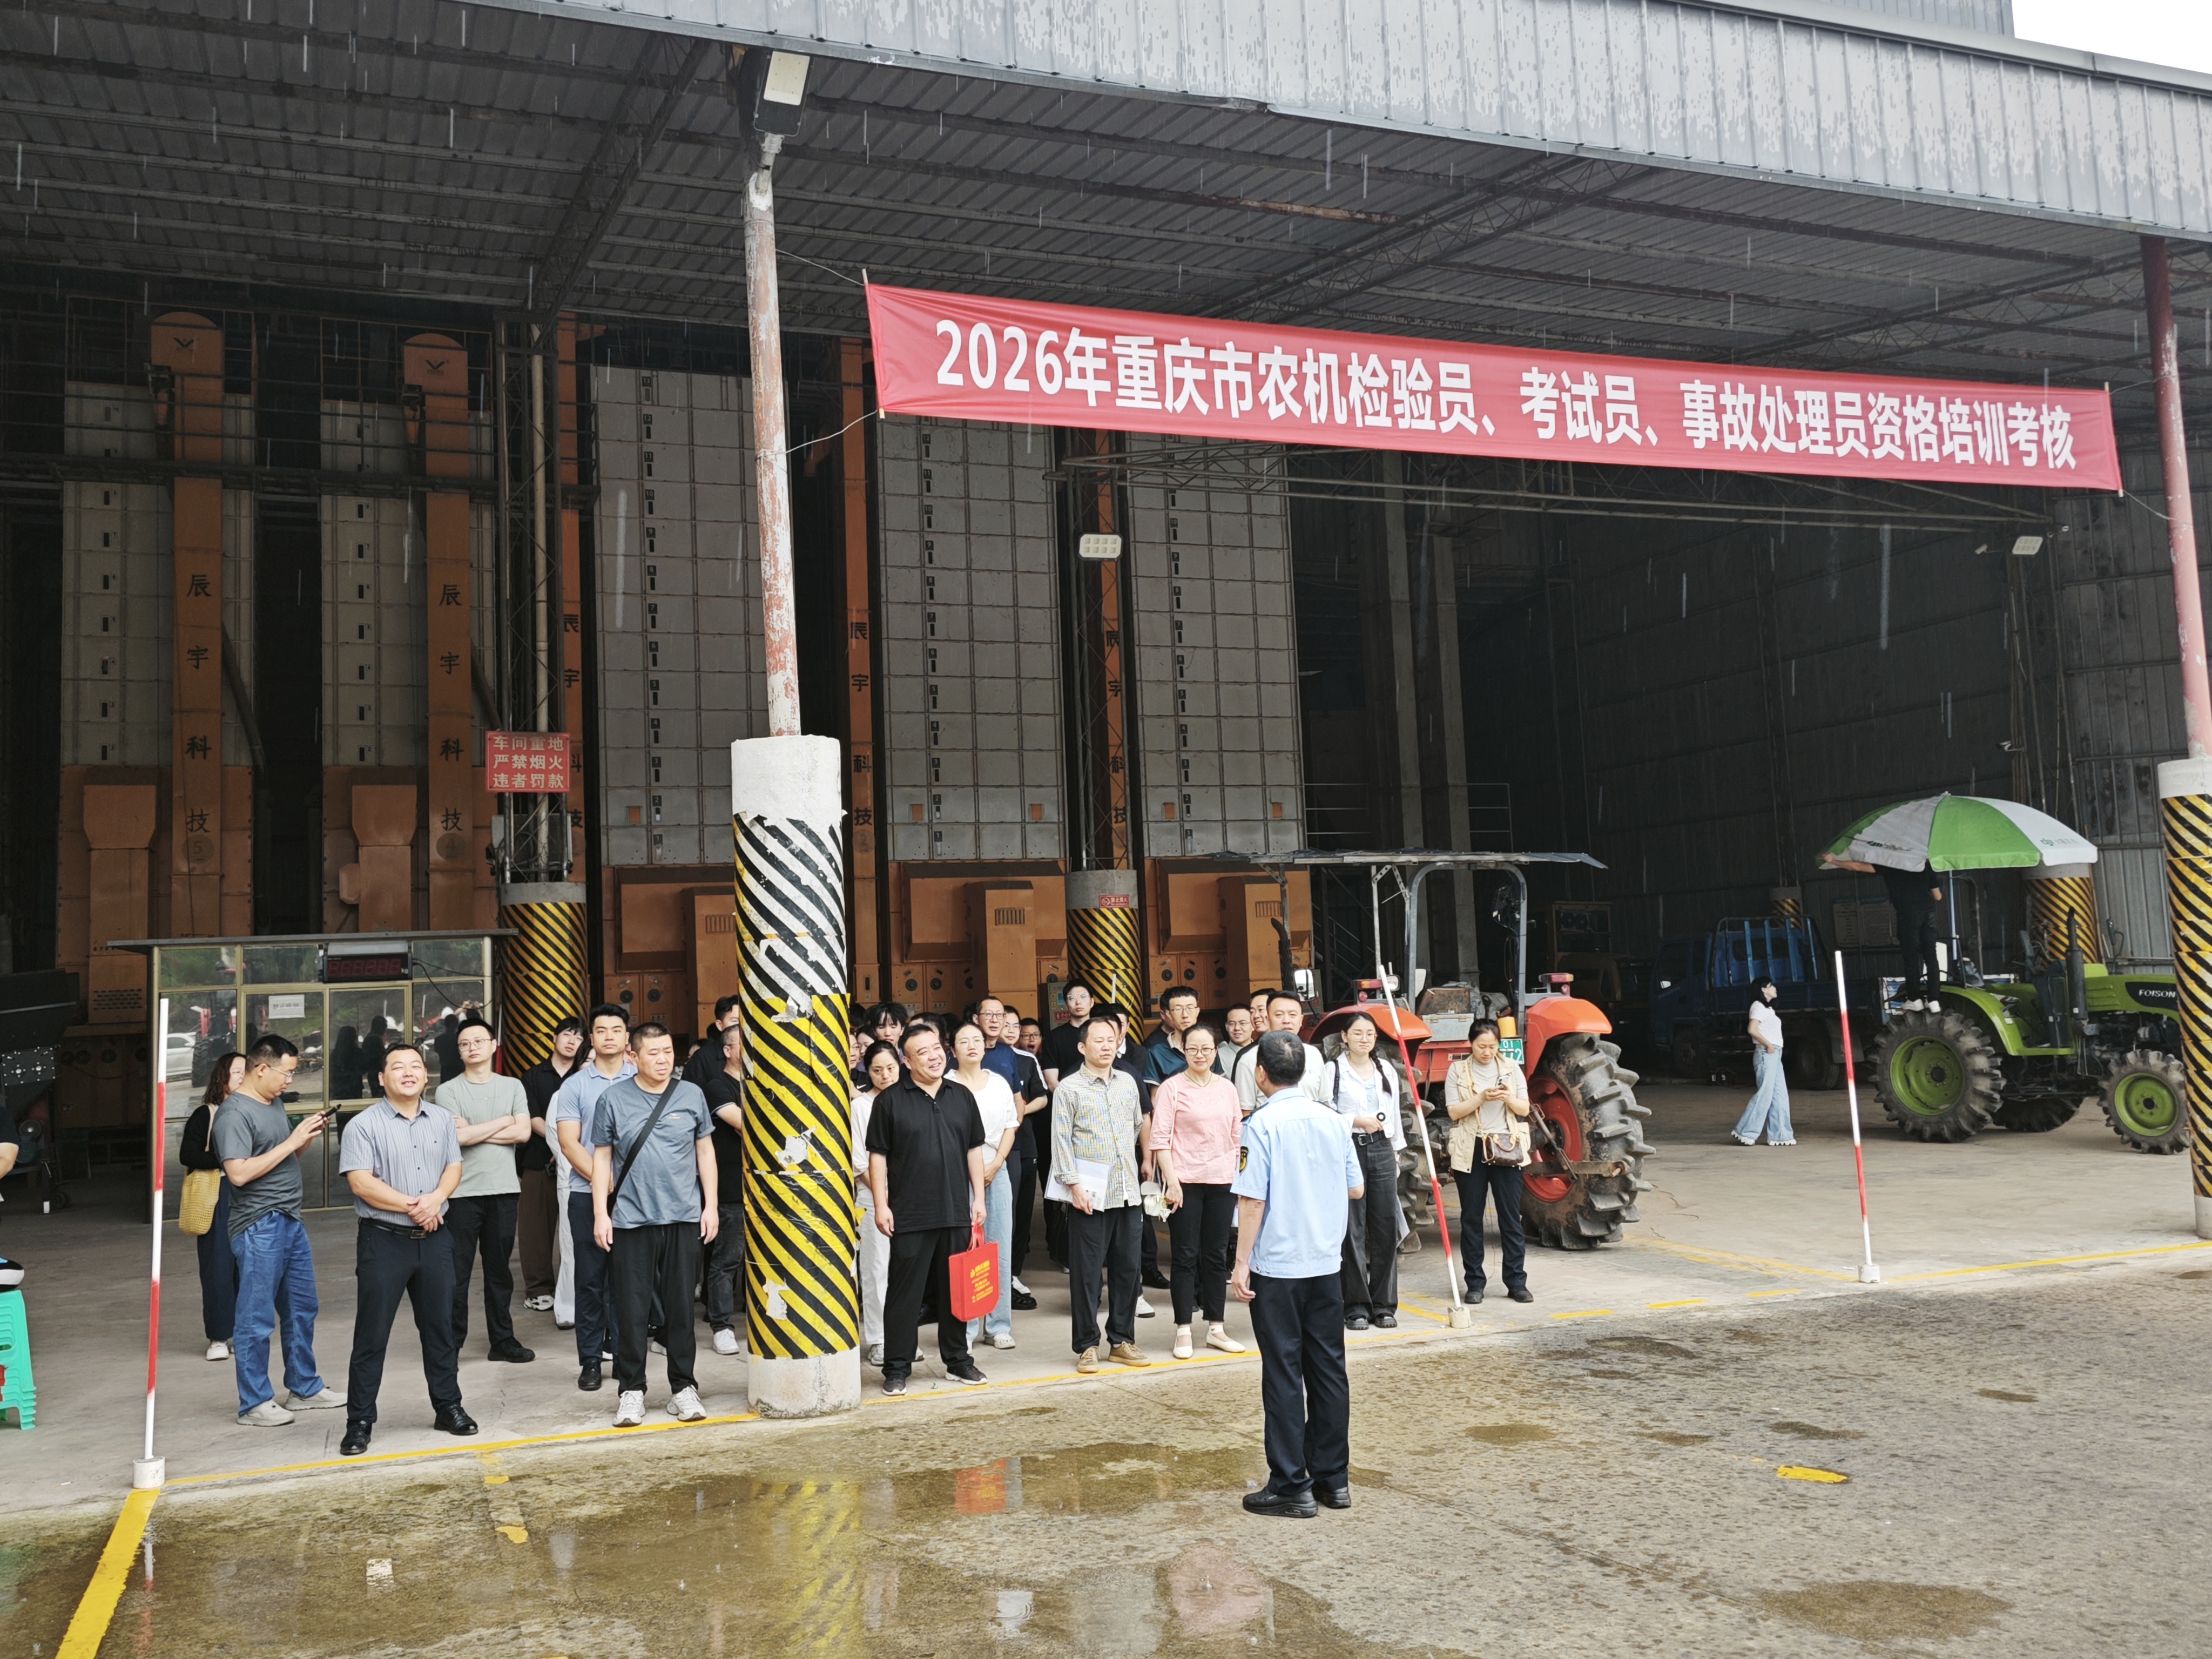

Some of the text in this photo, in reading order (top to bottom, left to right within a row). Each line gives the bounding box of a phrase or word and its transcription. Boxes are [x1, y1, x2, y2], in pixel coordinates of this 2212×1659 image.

[935, 318, 2076, 470] 2026年重庆市农机检验员、考试员、事故处理员资格培训考核
[185, 574, 212, 833] 辰宇科技
[439, 584, 464, 831] 辰宇科技
[493, 736, 564, 751] 车间重地
[851, 622, 872, 826] 辰宇科技
[493, 754, 563, 770] 严禁烟火
[493, 773, 564, 788] 违者罚款
[2139, 989, 2176, 998] FOISON
